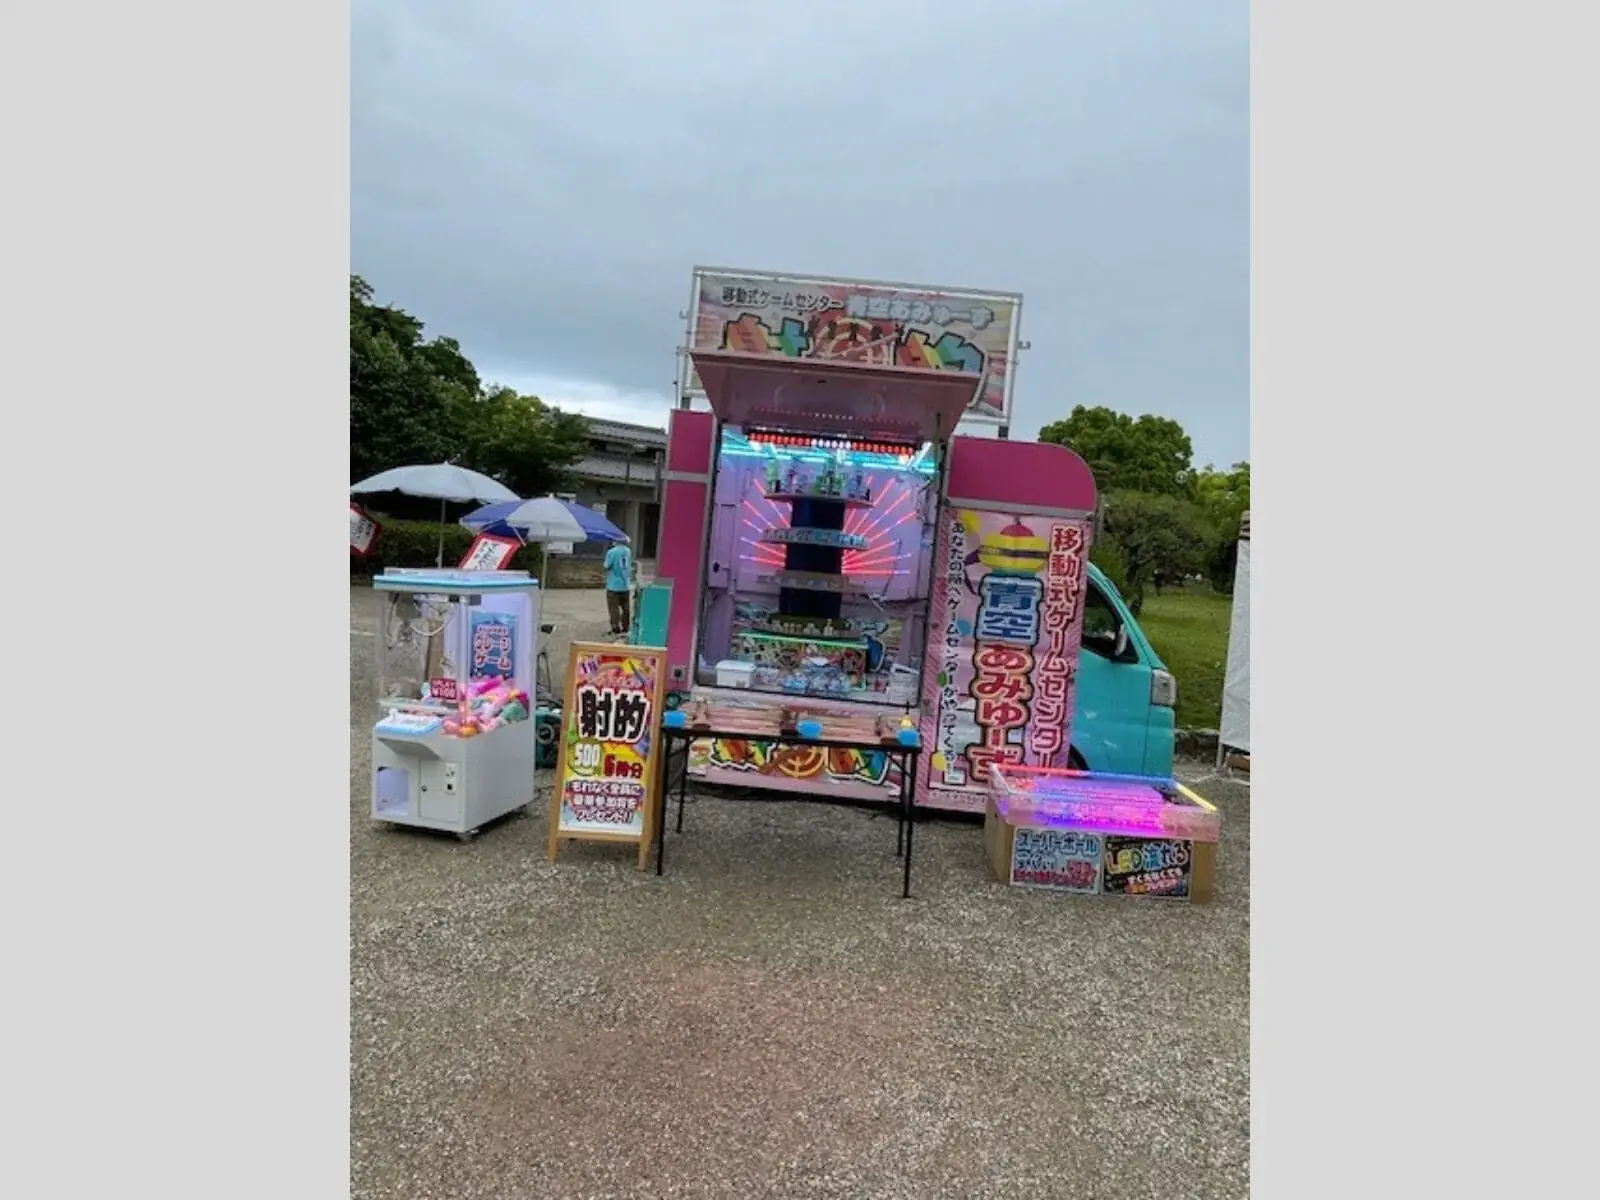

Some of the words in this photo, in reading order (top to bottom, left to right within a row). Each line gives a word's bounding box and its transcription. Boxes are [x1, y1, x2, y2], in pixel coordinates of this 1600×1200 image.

[1032, 524, 1083, 766] 移動式ゲームセンター
[579, 687, 648, 740] 射的
[1016, 830, 1100, 856] スーパーボール
